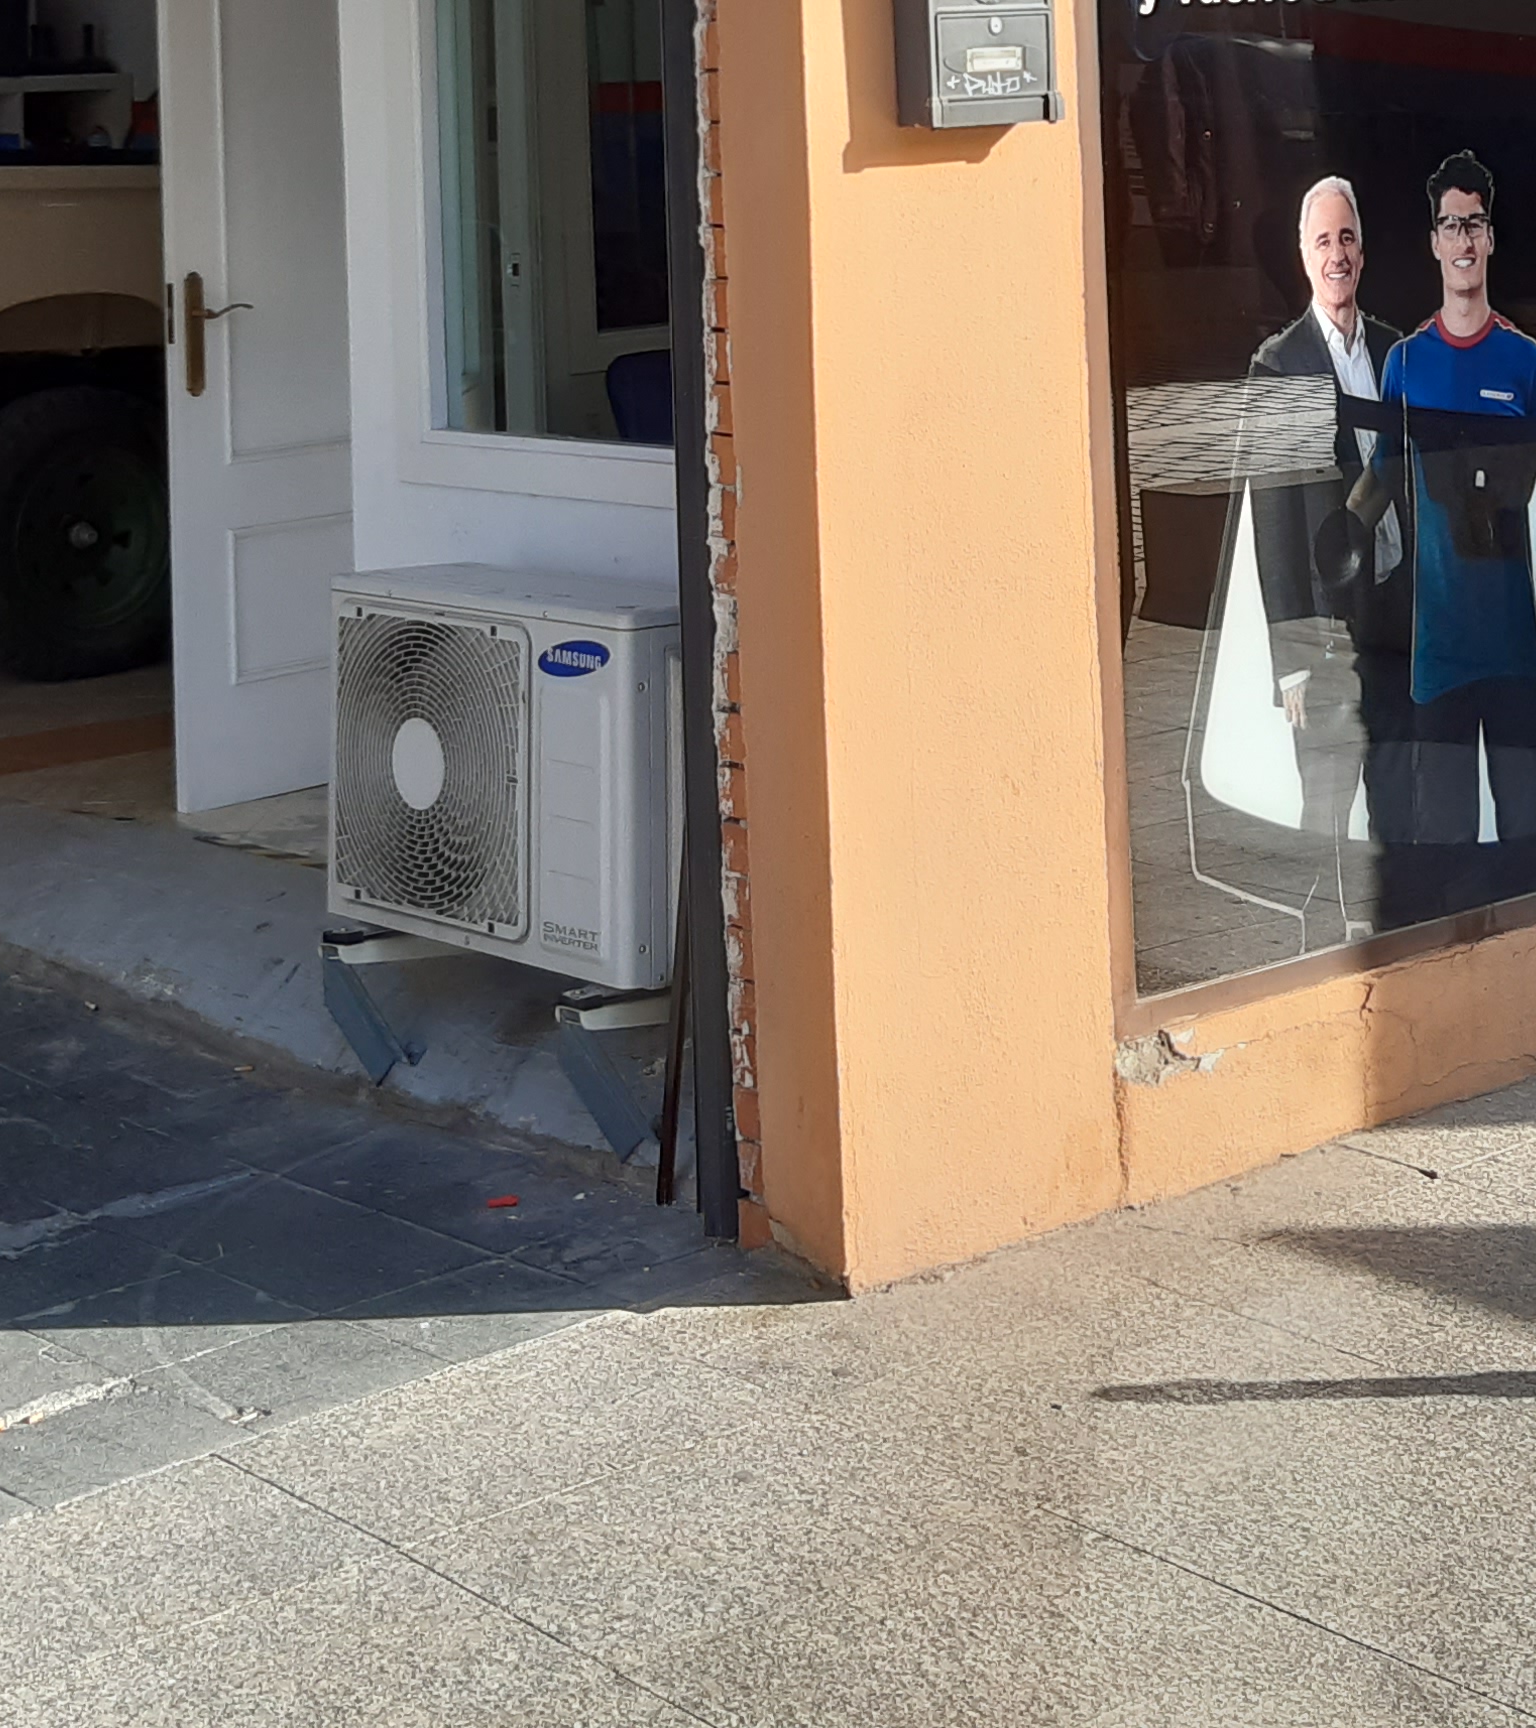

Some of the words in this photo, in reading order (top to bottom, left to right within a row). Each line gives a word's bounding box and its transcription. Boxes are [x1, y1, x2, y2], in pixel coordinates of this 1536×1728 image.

[546, 647, 602, 670] SAMSUNG
[543, 921, 599, 942] SMART
[543, 933, 599, 952] INVERTER
